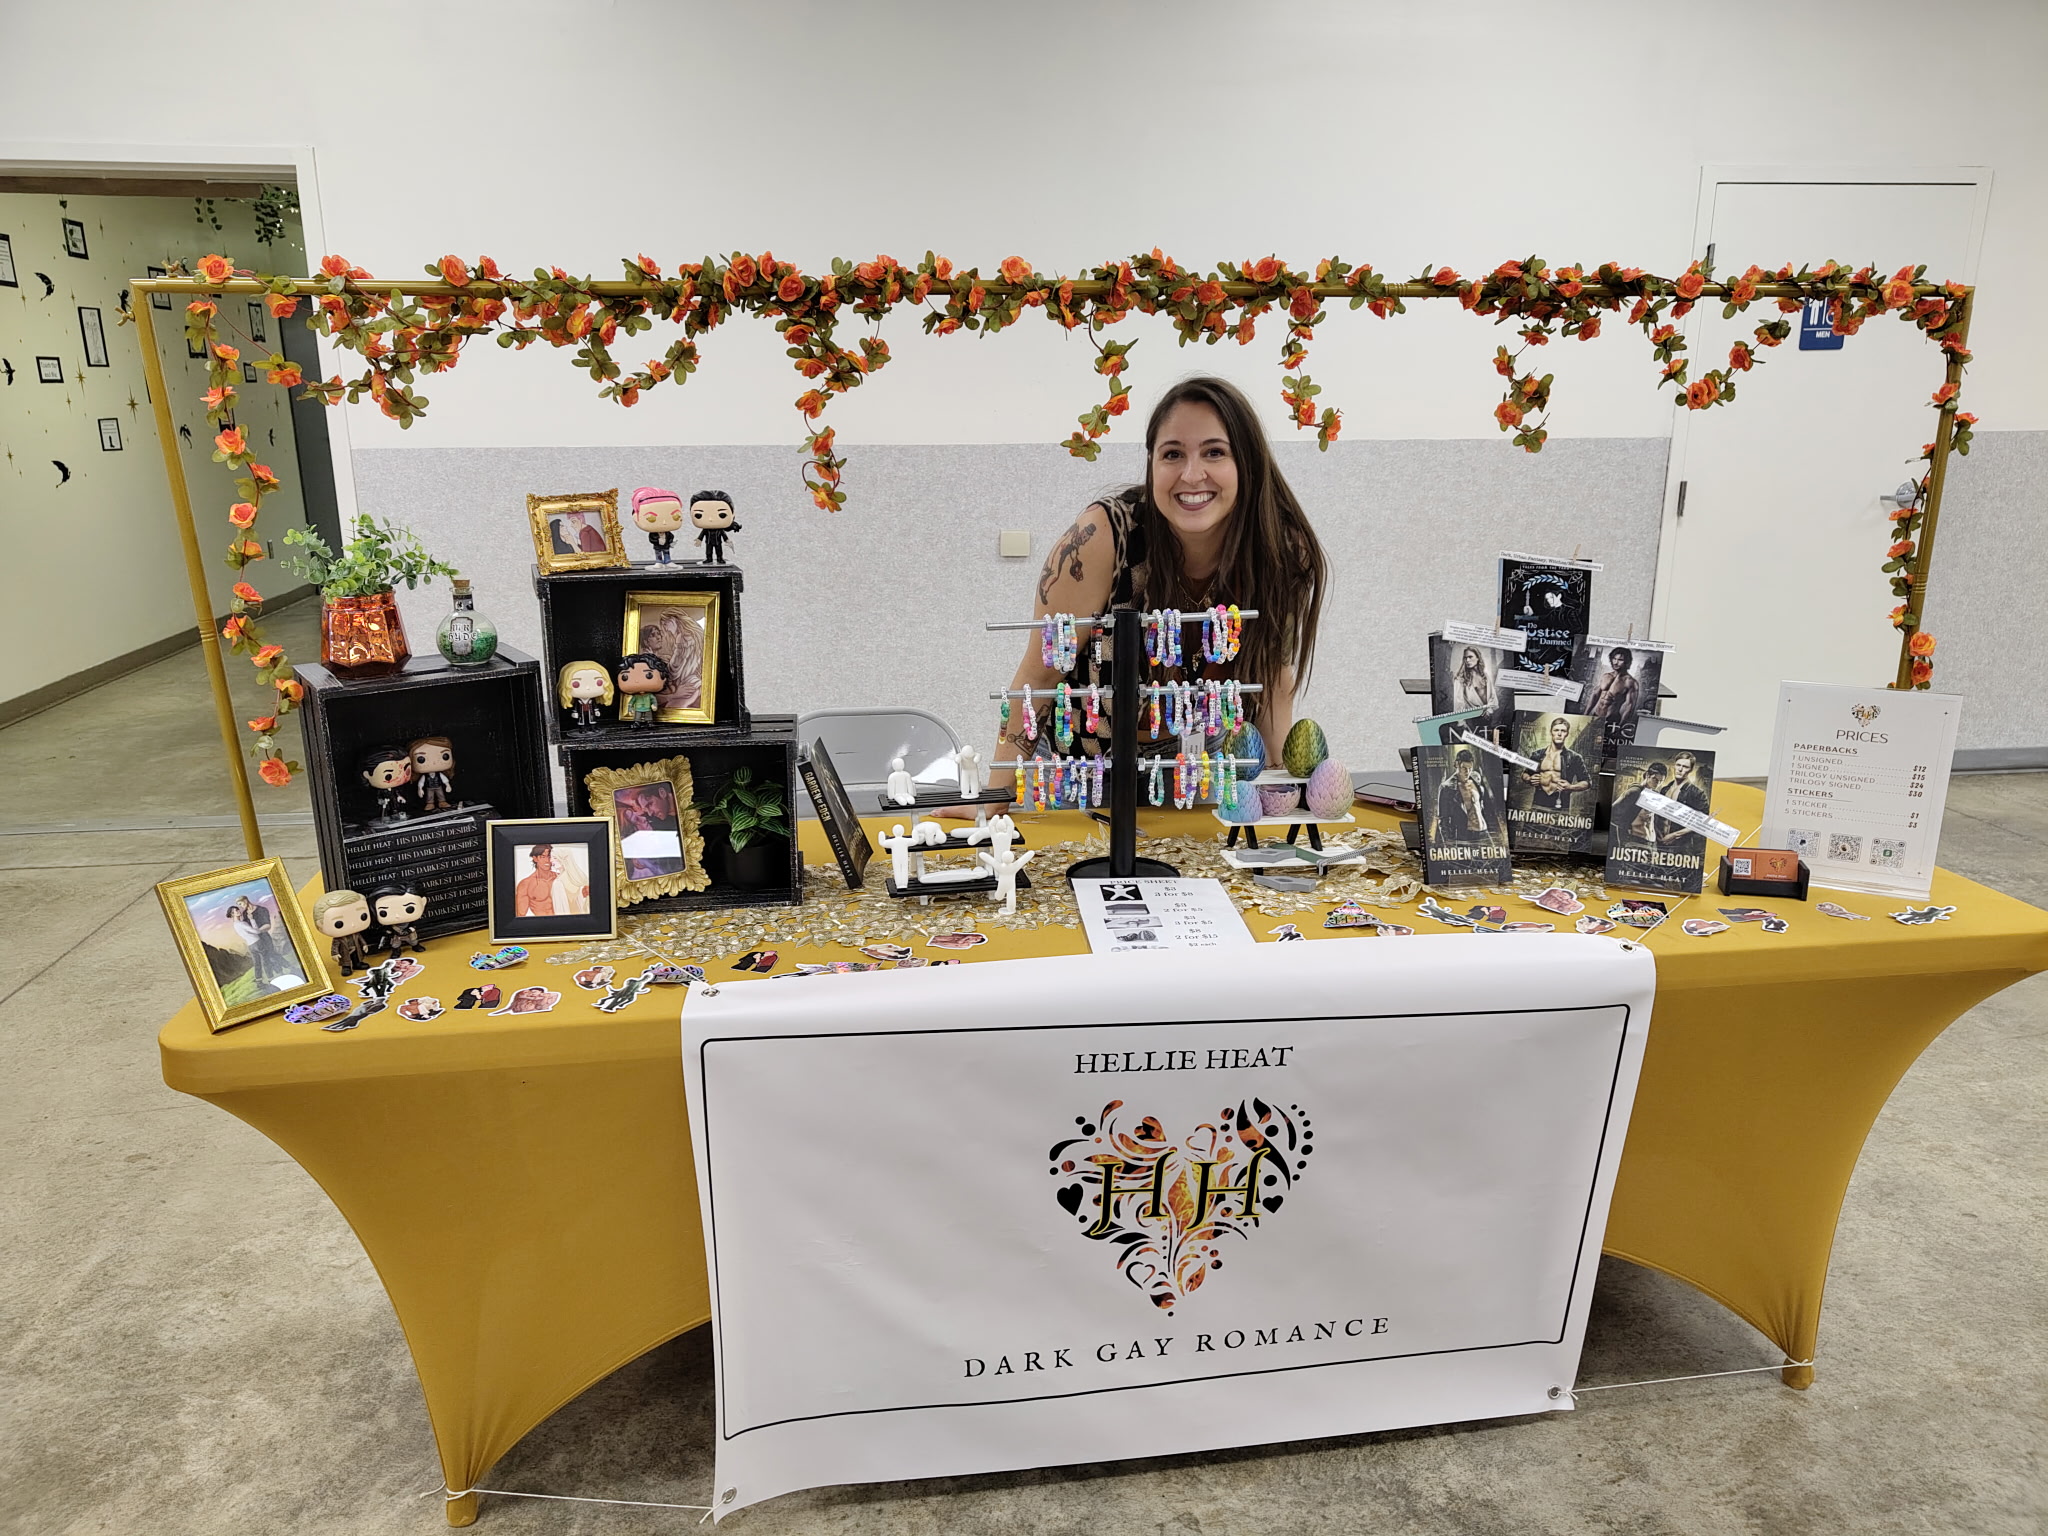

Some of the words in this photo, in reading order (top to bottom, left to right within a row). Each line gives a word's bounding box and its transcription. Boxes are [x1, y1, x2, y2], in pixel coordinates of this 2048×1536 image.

[1540, 638, 1572, 646] Damned
[1836, 730, 1889, 744] PRICES
[1794, 743, 1858, 754] PAPERBACKS
[1797, 763, 1829, 771] SIGNED
[1798, 755, 1843, 764] UNSIGNED
[1913, 764, 1927, 772] $12
[1789, 777, 1826, 786] TRILOGY
[1829, 781, 1862, 790] SIGNED
[1790, 770, 1828, 778] TRILOGY
[1830, 774, 1876, 784] UNSIGNED
[1787, 787, 1834, 798] STICKERS
[1792, 800, 1828, 809] STICKER
[804, 772, 822, 800] GARDEN
[818, 804, 832, 822] EDEN
[832, 834, 846, 858] HELLIE
[1507, 808, 1556, 825] TARTARUS
[1558, 815, 1593, 830] RISING
[1792, 809, 1833, 818] STICKERS
[347, 844, 371, 854] HELLIE
[412, 830, 444, 844] DARKEST
[446, 824, 478, 836] DESIRES
[1516, 830, 1548, 839] HELLIE
[349, 860, 372, 870] HELLIE
[413, 846, 446, 858] DARKEST
[448, 840, 479, 852] DESIRES
[1430, 846, 1472, 861] GARDEN
[1472, 849, 1479, 857] OF
[1481, 846, 1507, 859] EDEN
[1610, 847, 1650, 864] JUSTIS
[1651, 851, 1700, 870] REBORN
[352, 876, 376, 887] HELLIE
[416, 862, 449, 874] DARKEST
[451, 856, 482, 866] DESIRES
[454, 870, 485, 882] DESIRES
[1618, 870, 1655, 879] HELLIE
[1660, 874, 1687, 883] HEAT
[428, 904, 461, 918] DARKEST
[1074, 1050, 1197, 1074] HELLIE
[1205, 1046, 1294, 1070] HEAT
[963, 1348, 1074, 1378] DARK
[1096, 1336, 1174, 1363] GAY
[1195, 1316, 1391, 1353] ROMANCE
